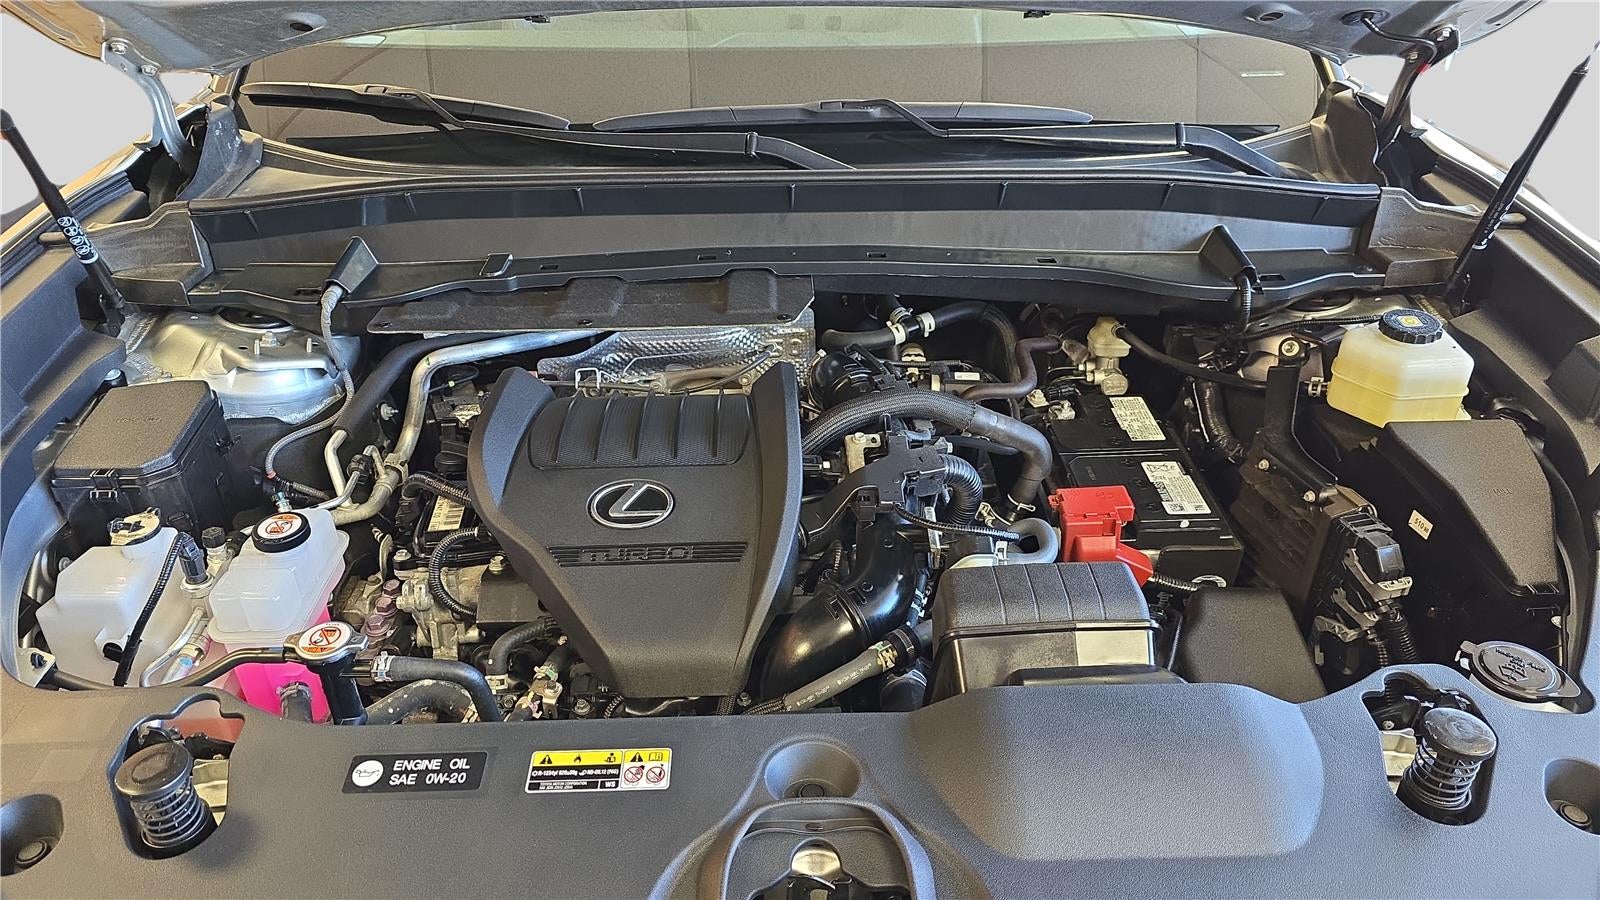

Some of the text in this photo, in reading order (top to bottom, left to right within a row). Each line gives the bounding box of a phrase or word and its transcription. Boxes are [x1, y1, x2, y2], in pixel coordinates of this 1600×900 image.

[393, 758, 471, 771] ENGINE OIL
[388, 772, 467, 786] SAE 0W-20
